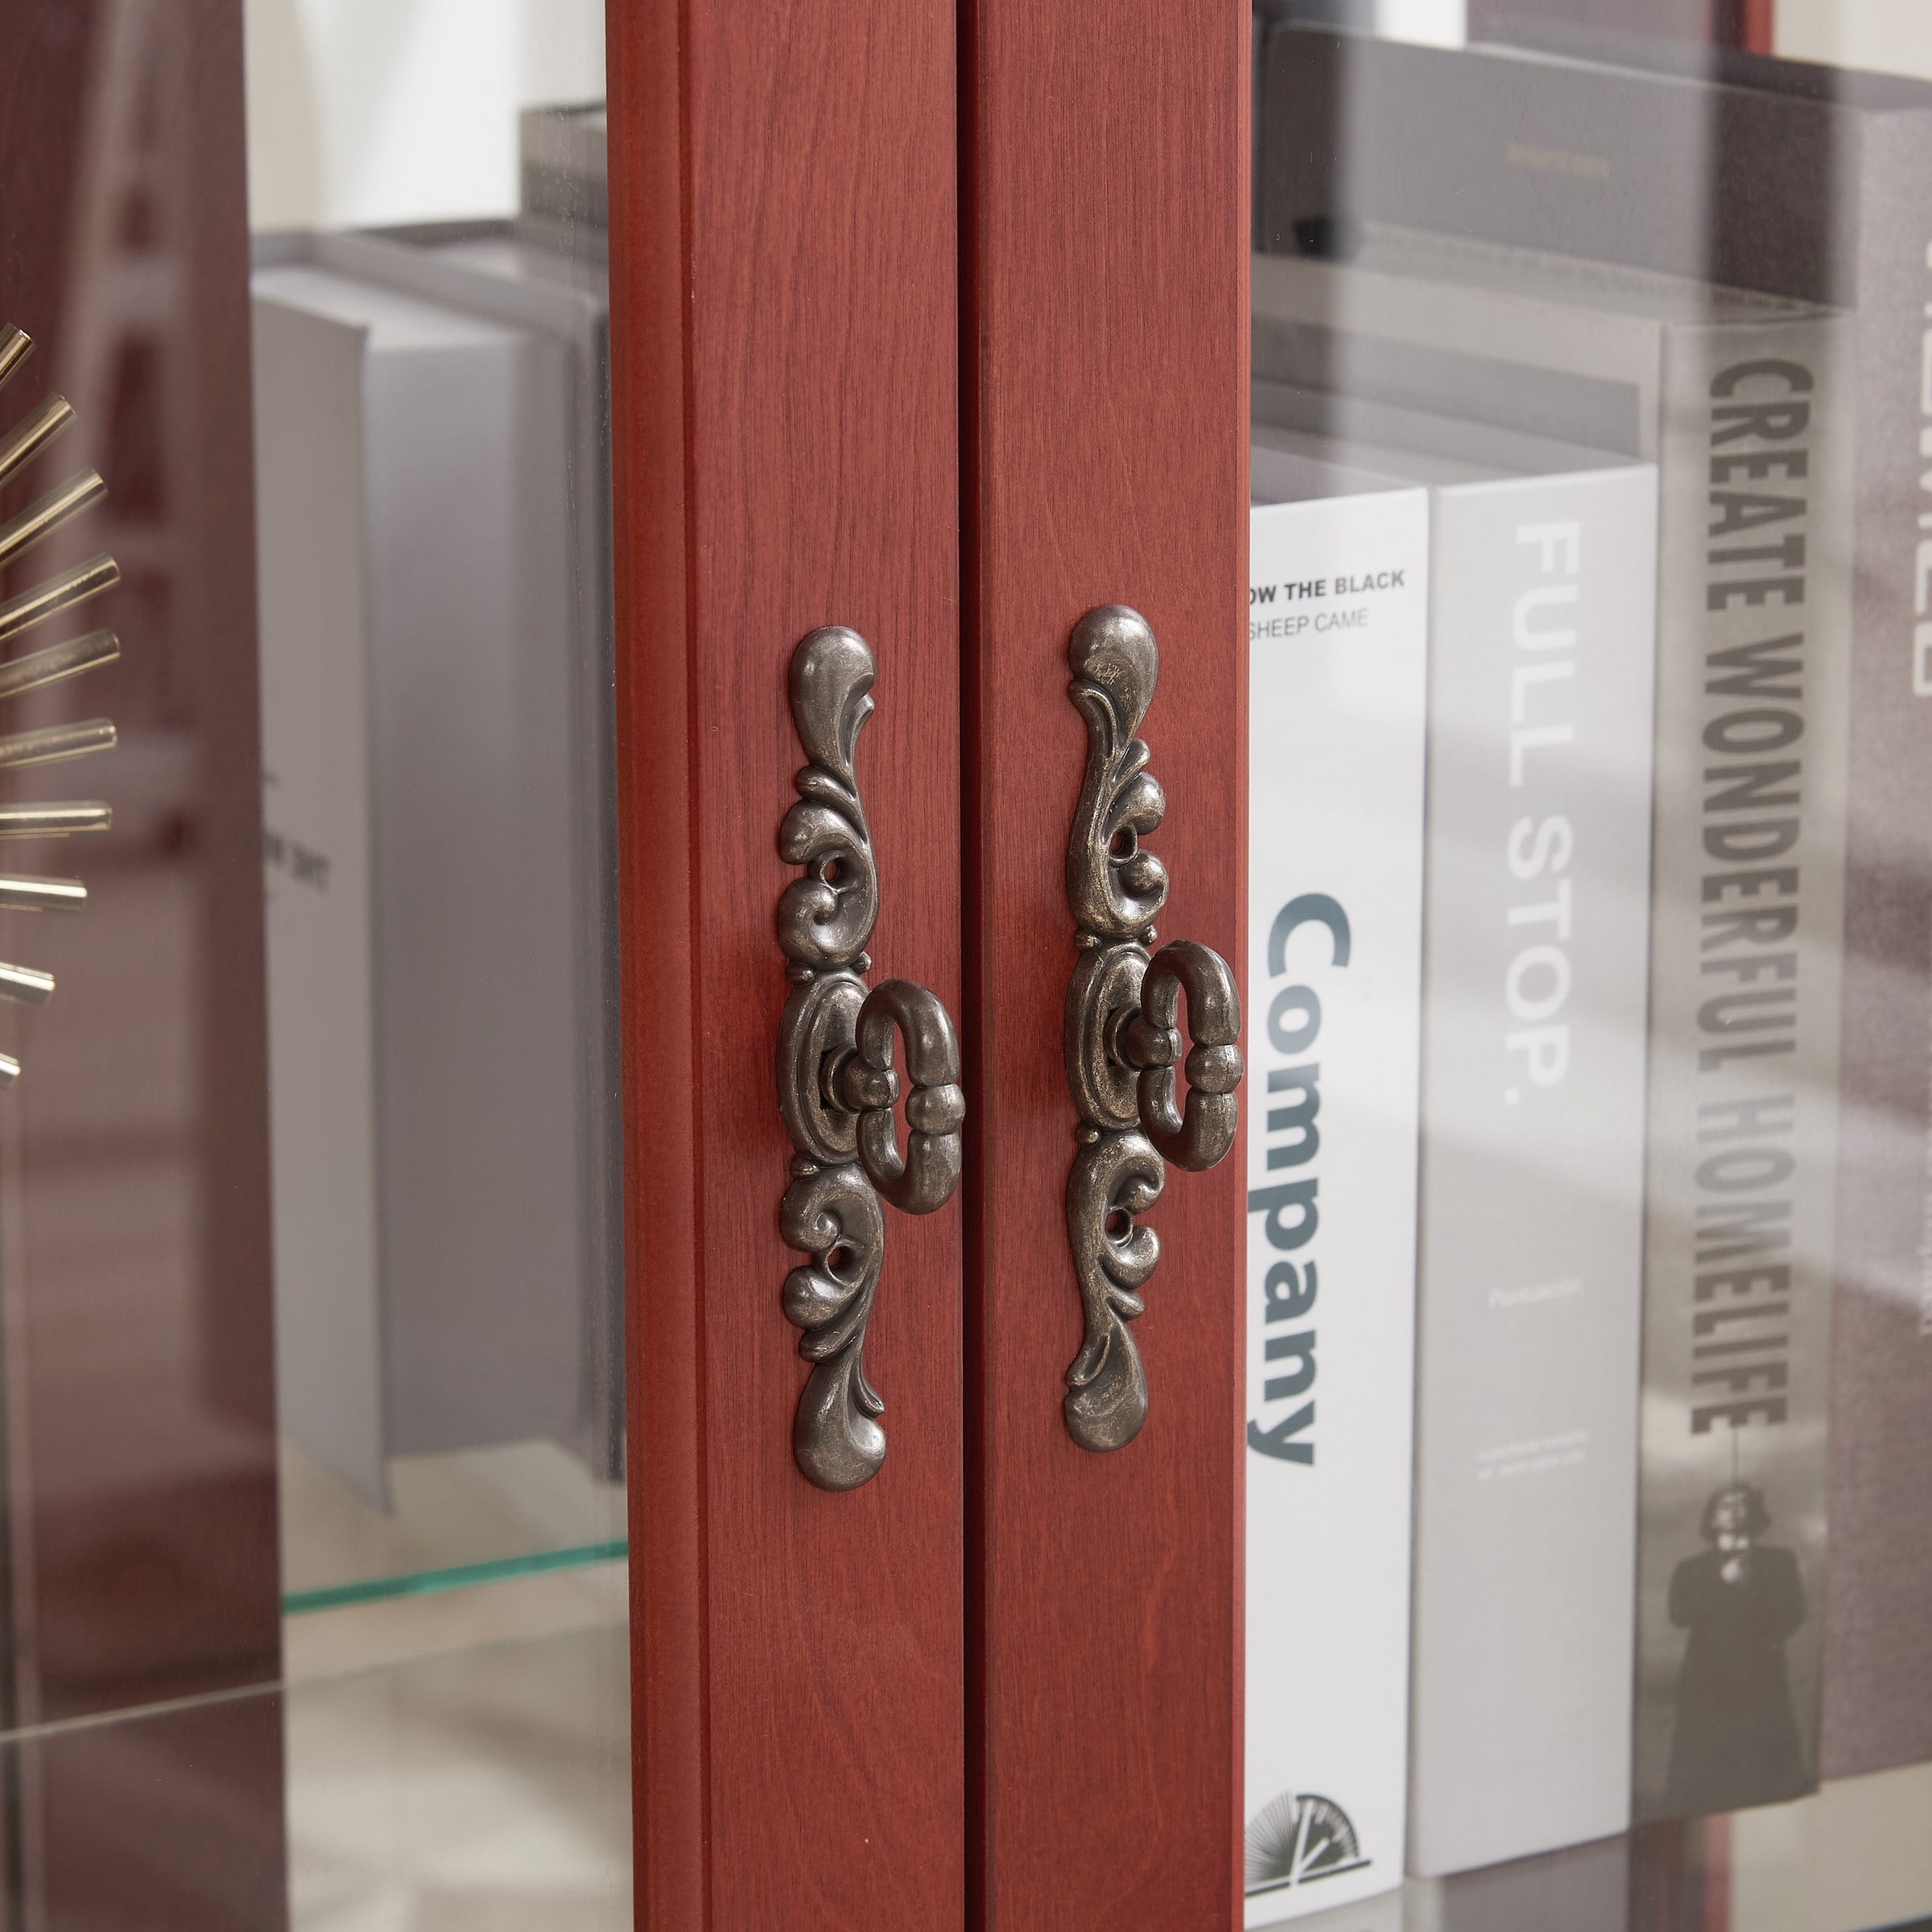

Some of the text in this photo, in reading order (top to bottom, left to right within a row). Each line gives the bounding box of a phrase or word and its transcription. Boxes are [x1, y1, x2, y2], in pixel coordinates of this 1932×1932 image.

[1284, 580, 1327, 601] THE
[1335, 570, 1405, 595] BLACK
[1314, 608, 1369, 631] CAME
[1505, 520, 1580, 1105] FULL STOP.
[1247, 893, 1351, 1467] Company
[1691, 358, 1814, 1436] CREATE WONDERFUL HOMELIFE
